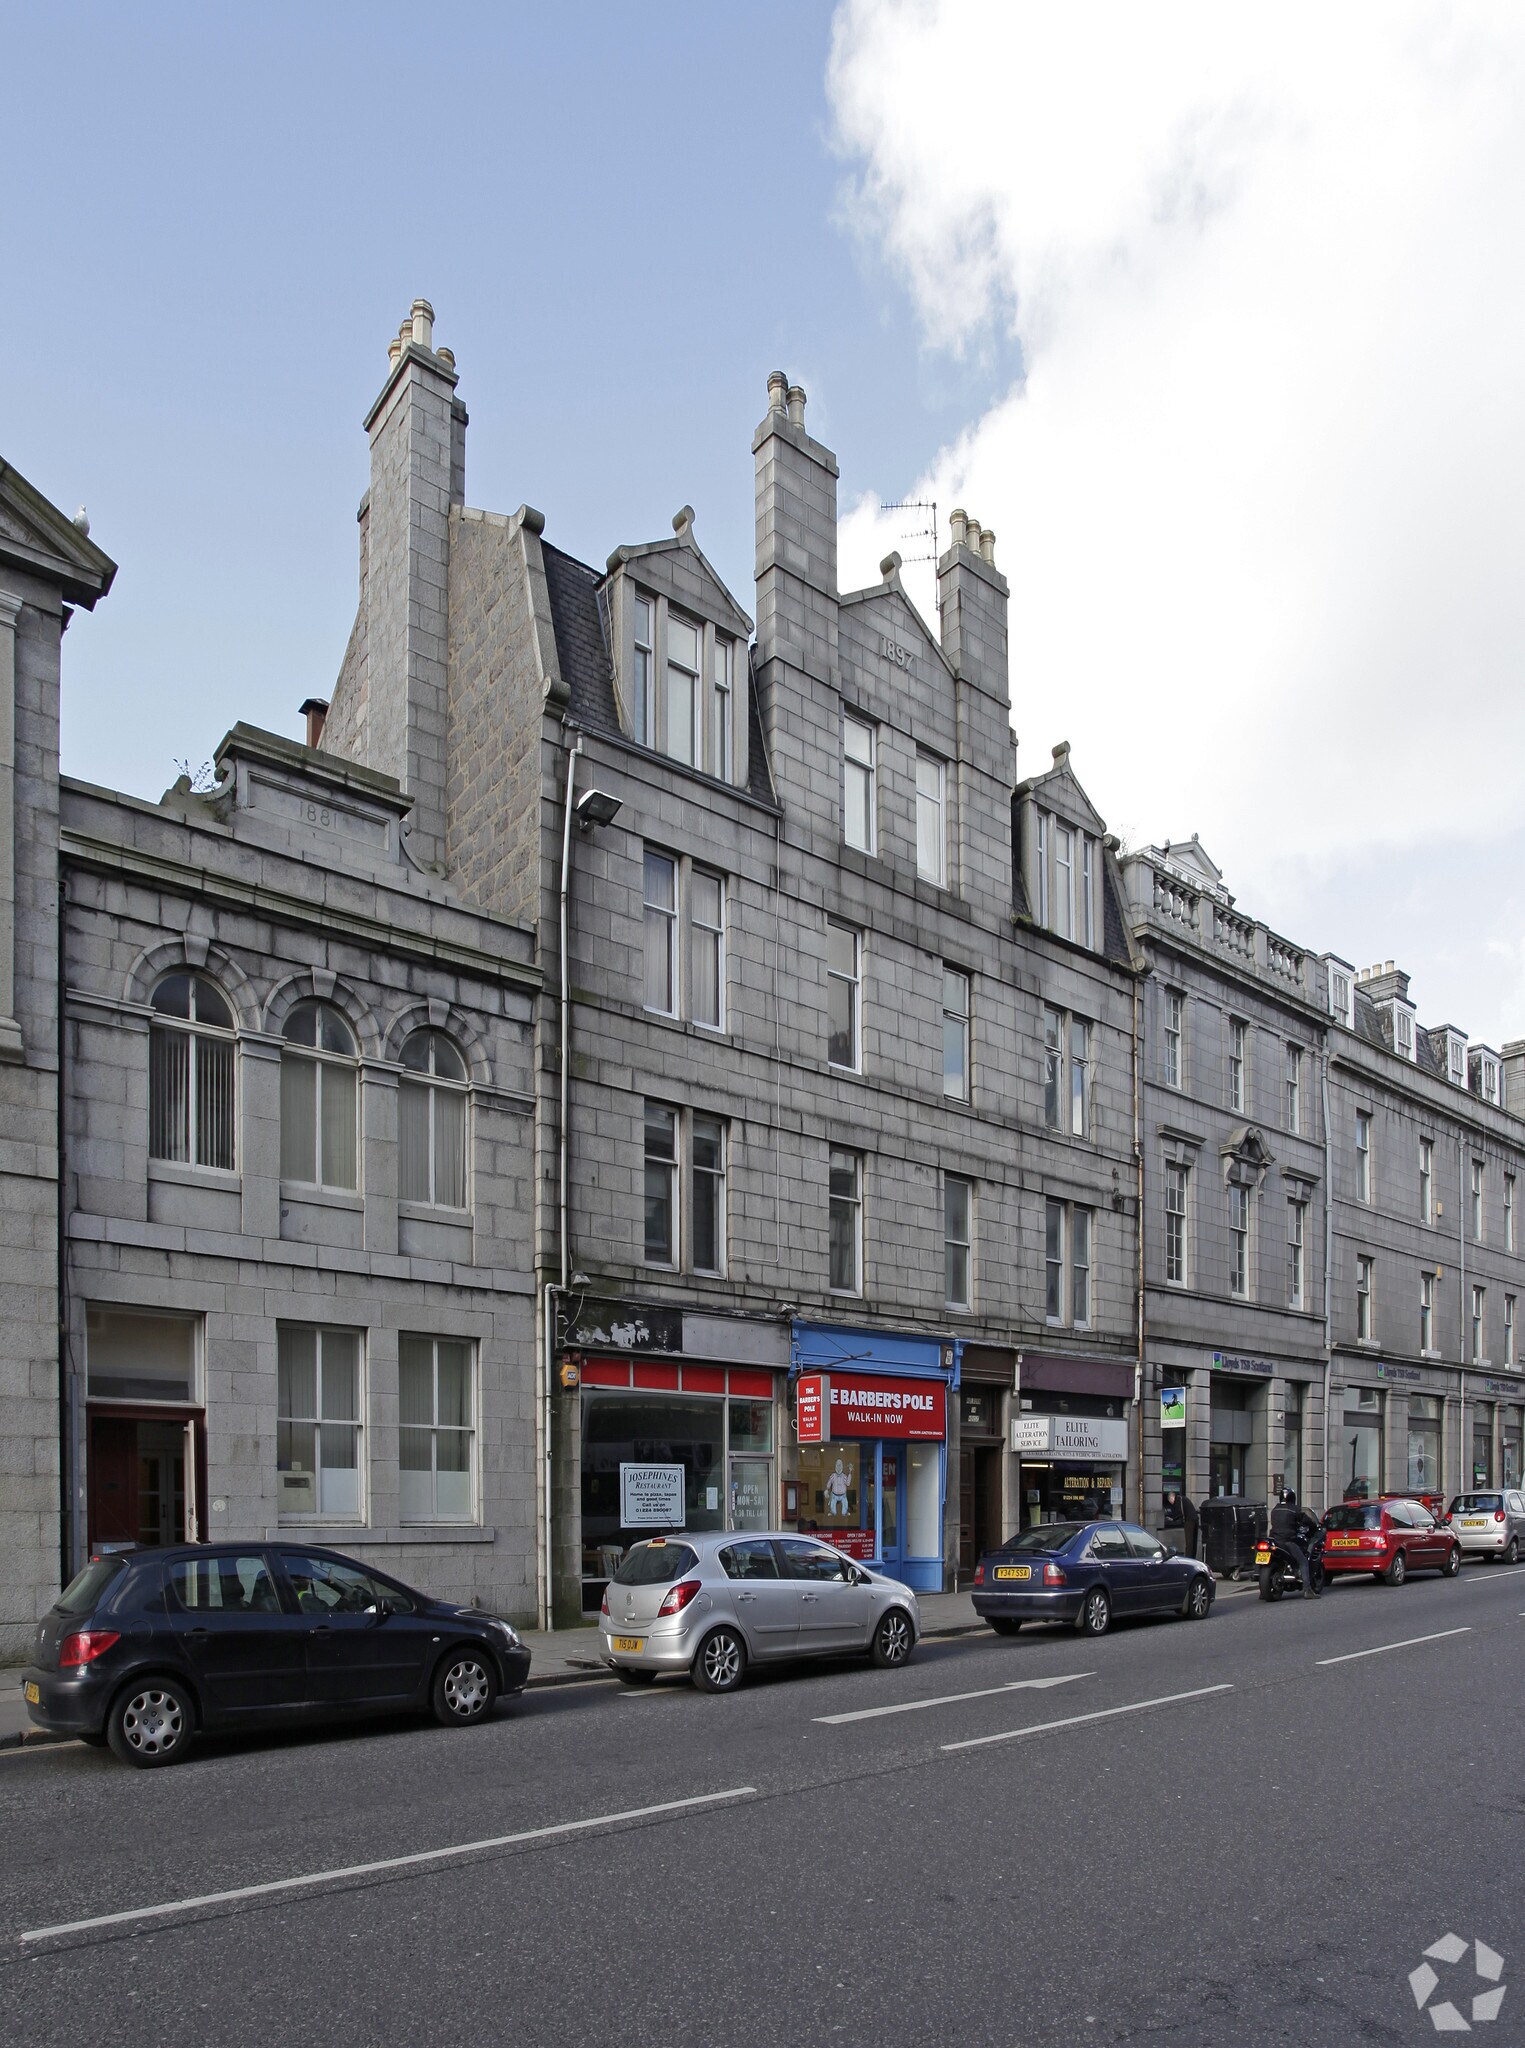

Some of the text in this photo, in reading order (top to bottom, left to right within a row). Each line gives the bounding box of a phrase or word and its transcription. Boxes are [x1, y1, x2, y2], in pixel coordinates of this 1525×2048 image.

[882, 637, 914, 671] 1897
[300, 801, 337, 829] 1881
[1222, 1356, 1273, 1373] Lloyds TSB Scotland
[800, 1396, 821, 1404] BARBER'S
[841, 1389, 901, 1409] BARBER'S
[903, 1394, 934, 1410] POLE
[848, 1412, 903, 1424] WALK-IN NOW
[1023, 1422, 1039, 1430] ELITE
[1065, 1421, 1089, 1433] ELITE
[1016, 1430, 1048, 1439] ALTERATION
[1020, 1439, 1042, 1447] SERVICE
[1055, 1435, 1099, 1448] TAILORING
[628, 1472, 678, 1483] JOSEPHINES
[1063, 1477, 1113, 1489] ALTERATION & REPAIRS
[743, 1484, 759, 1495] OPEN
[737, 1495, 765, 1506] MON-SAT
[746, 1509, 756, 1518] TILL
[1000, 1569, 1027, 1577] Y347 SSA
